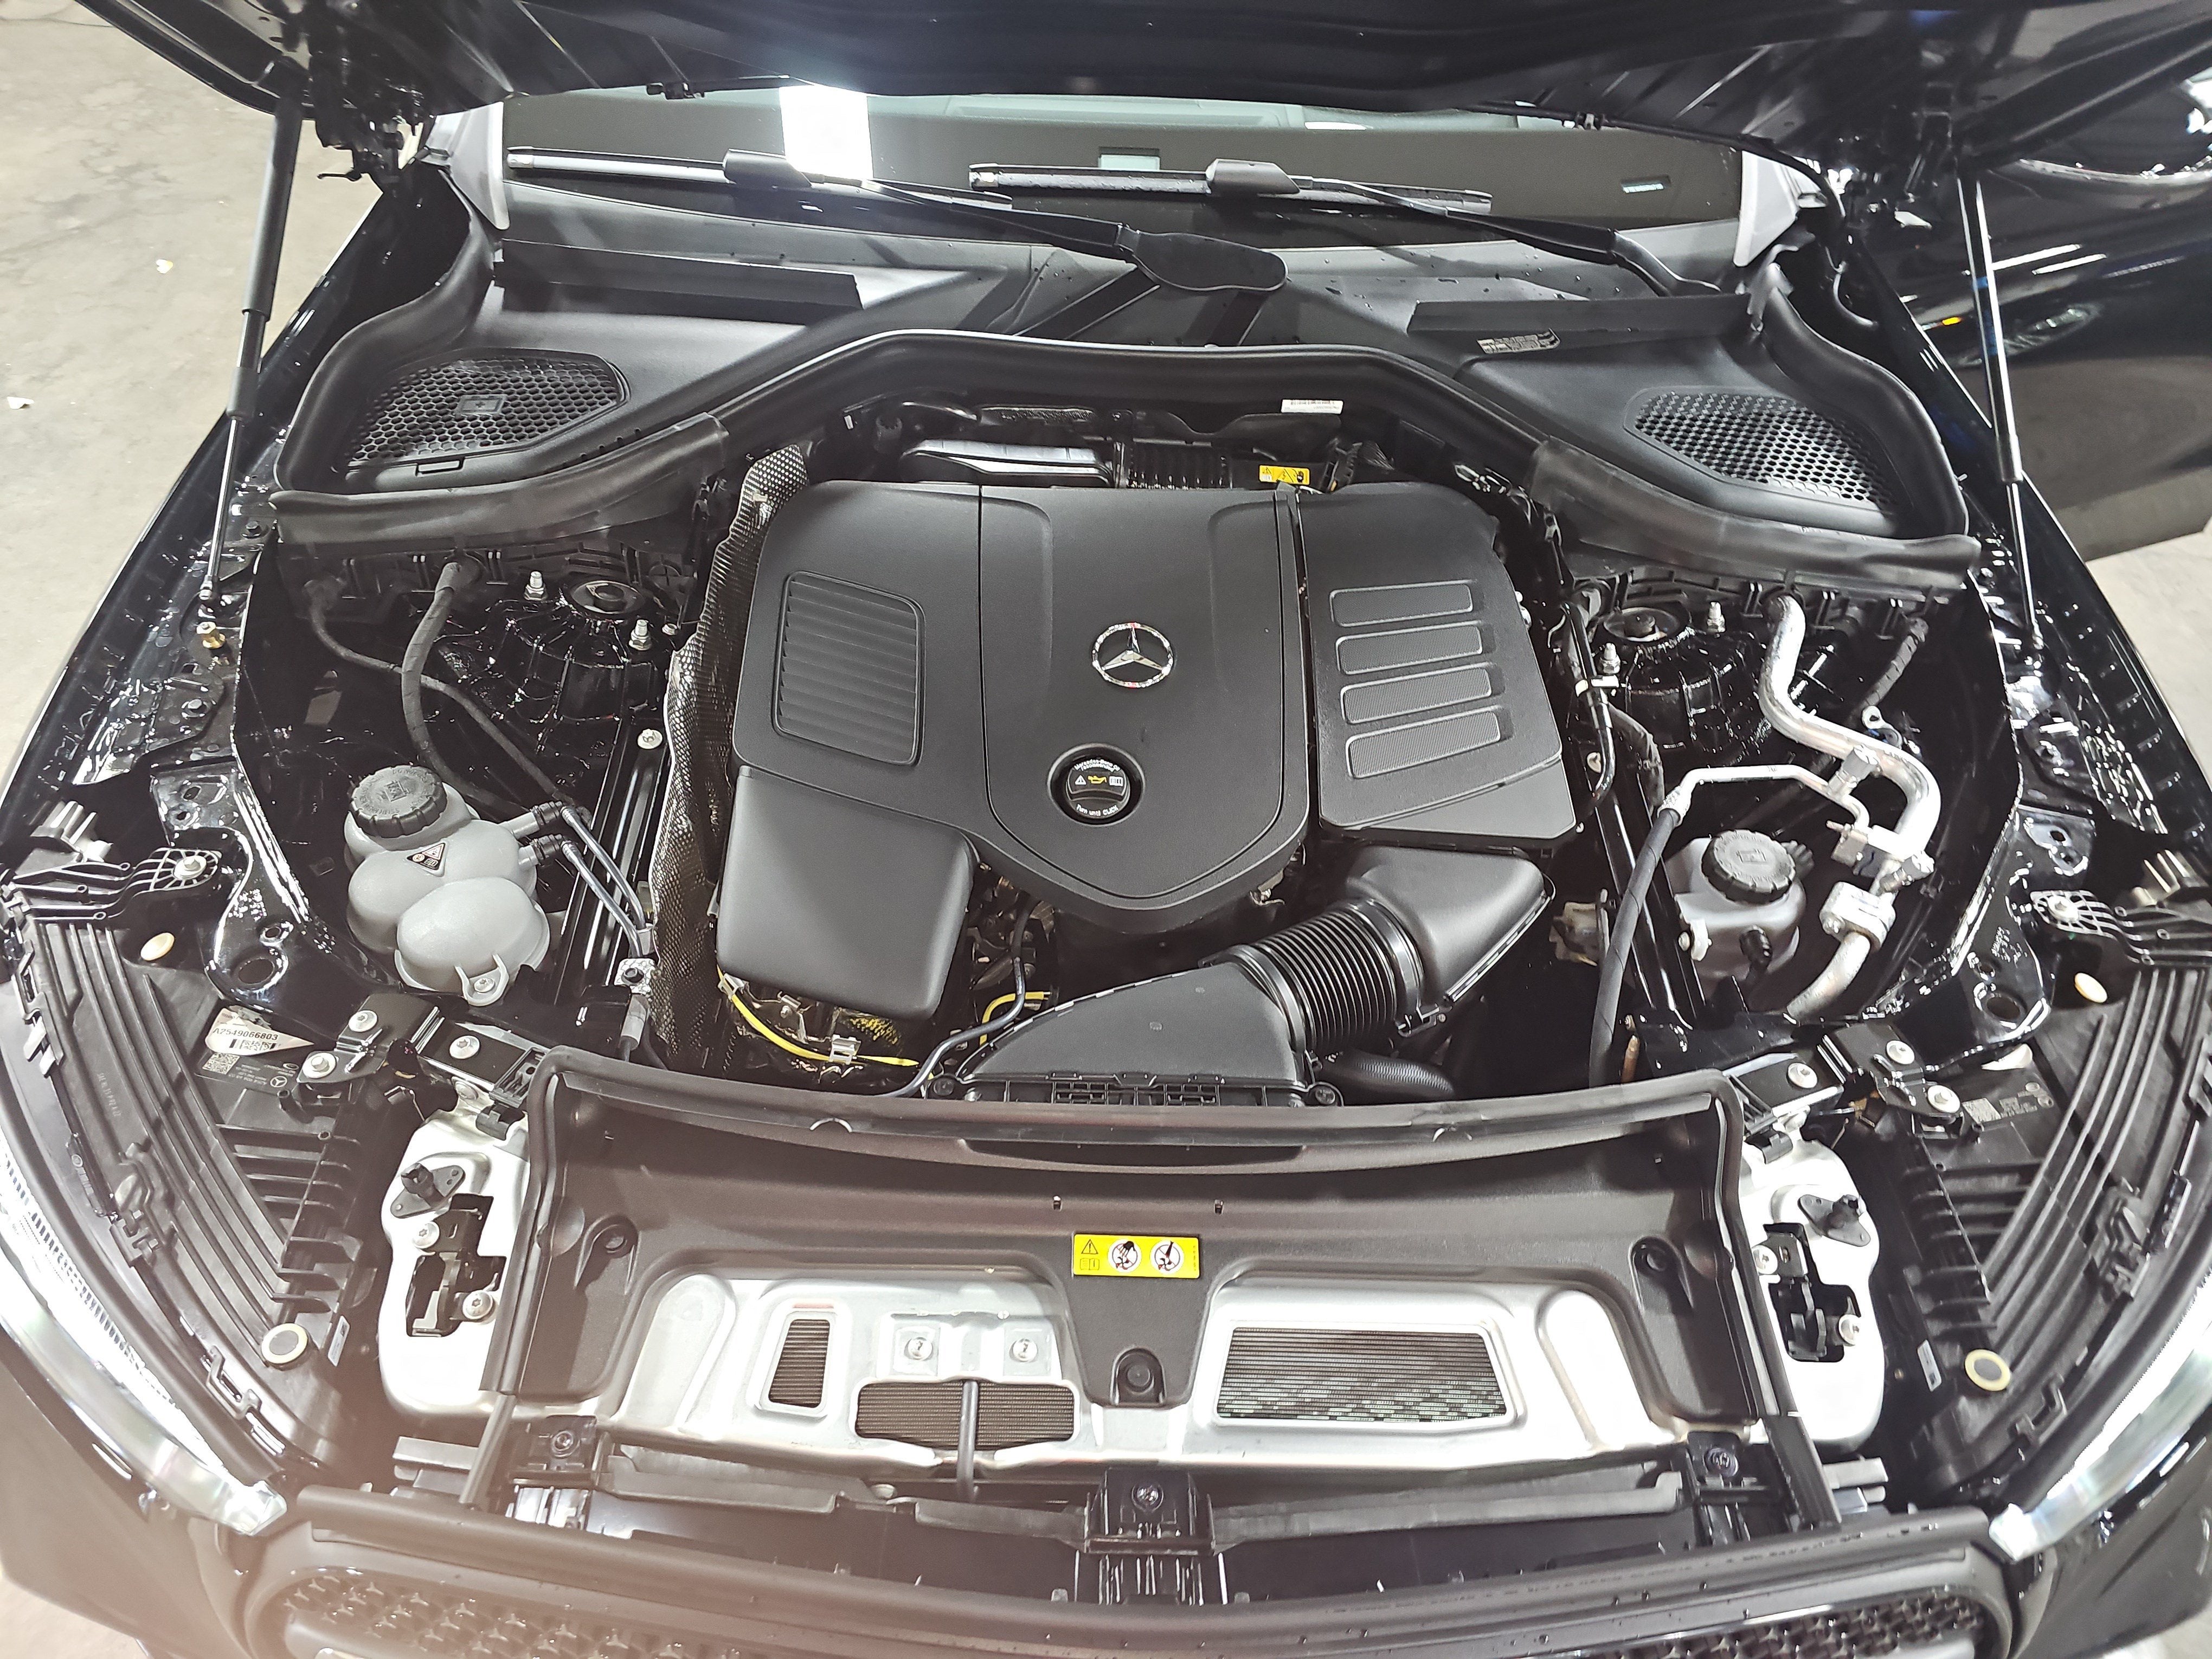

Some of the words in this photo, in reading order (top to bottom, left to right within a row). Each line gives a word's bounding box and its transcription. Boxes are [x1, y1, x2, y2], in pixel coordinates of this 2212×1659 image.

[1076, 803, 1088, 814] Turn
[1103, 805, 1118, 815] CLICK
[213, 1028, 279, 1040] A2549066803
